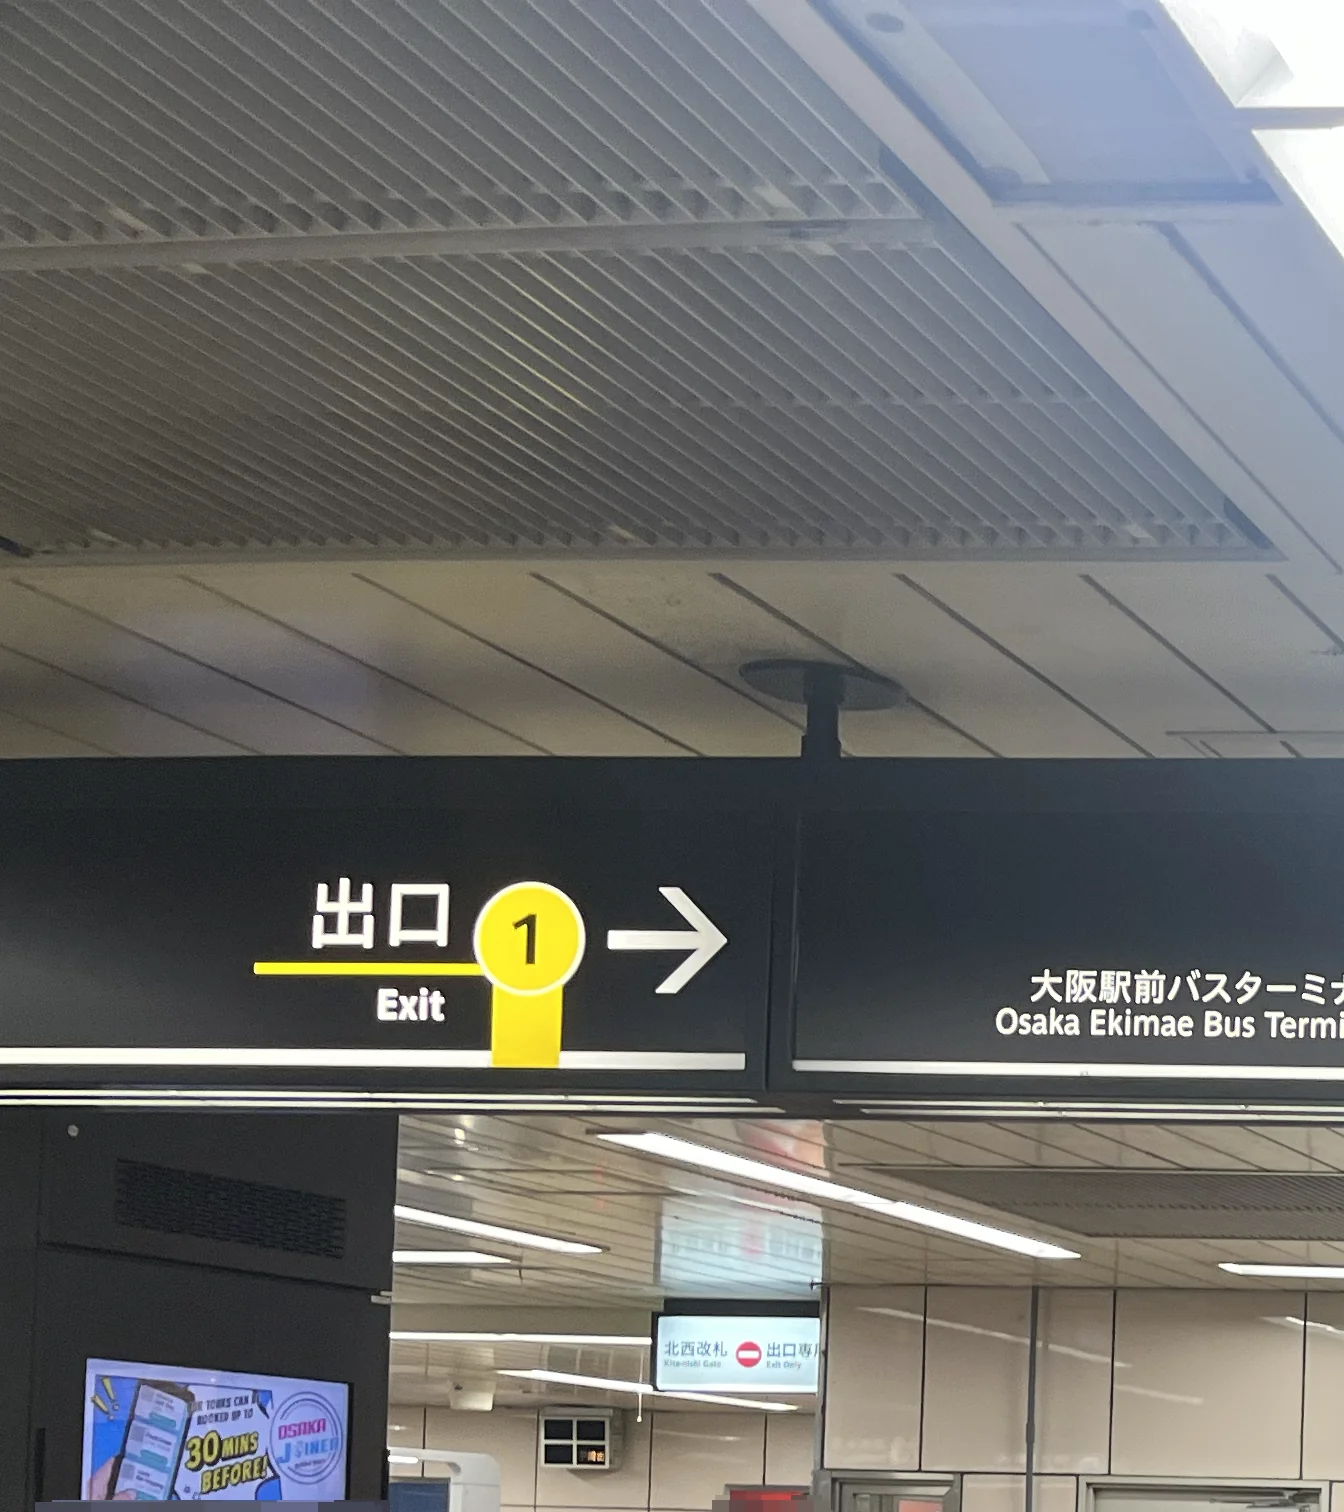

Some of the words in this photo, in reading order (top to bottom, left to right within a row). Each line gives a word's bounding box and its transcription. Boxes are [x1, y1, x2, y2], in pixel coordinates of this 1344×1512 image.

[311, 877, 450, 950] 出口
[511, 913, 538, 965] 1
[376, 986, 446, 1022] Exit
[995, 1007, 1081, 1036] Osaka
[1090, 1007, 1194, 1038] Ekimae
[1204, 1010, 1256, 1038] Bus
[664, 1341, 728, 1357] 北西改札
[766, 1342, 819, 1358] 出口専
[278, 1418, 327, 1440] OSAKA
[184, 1429, 222, 1472] 30
[221, 1430, 260, 1461] MINS
[200, 1453, 269, 1495] BEFORE!
